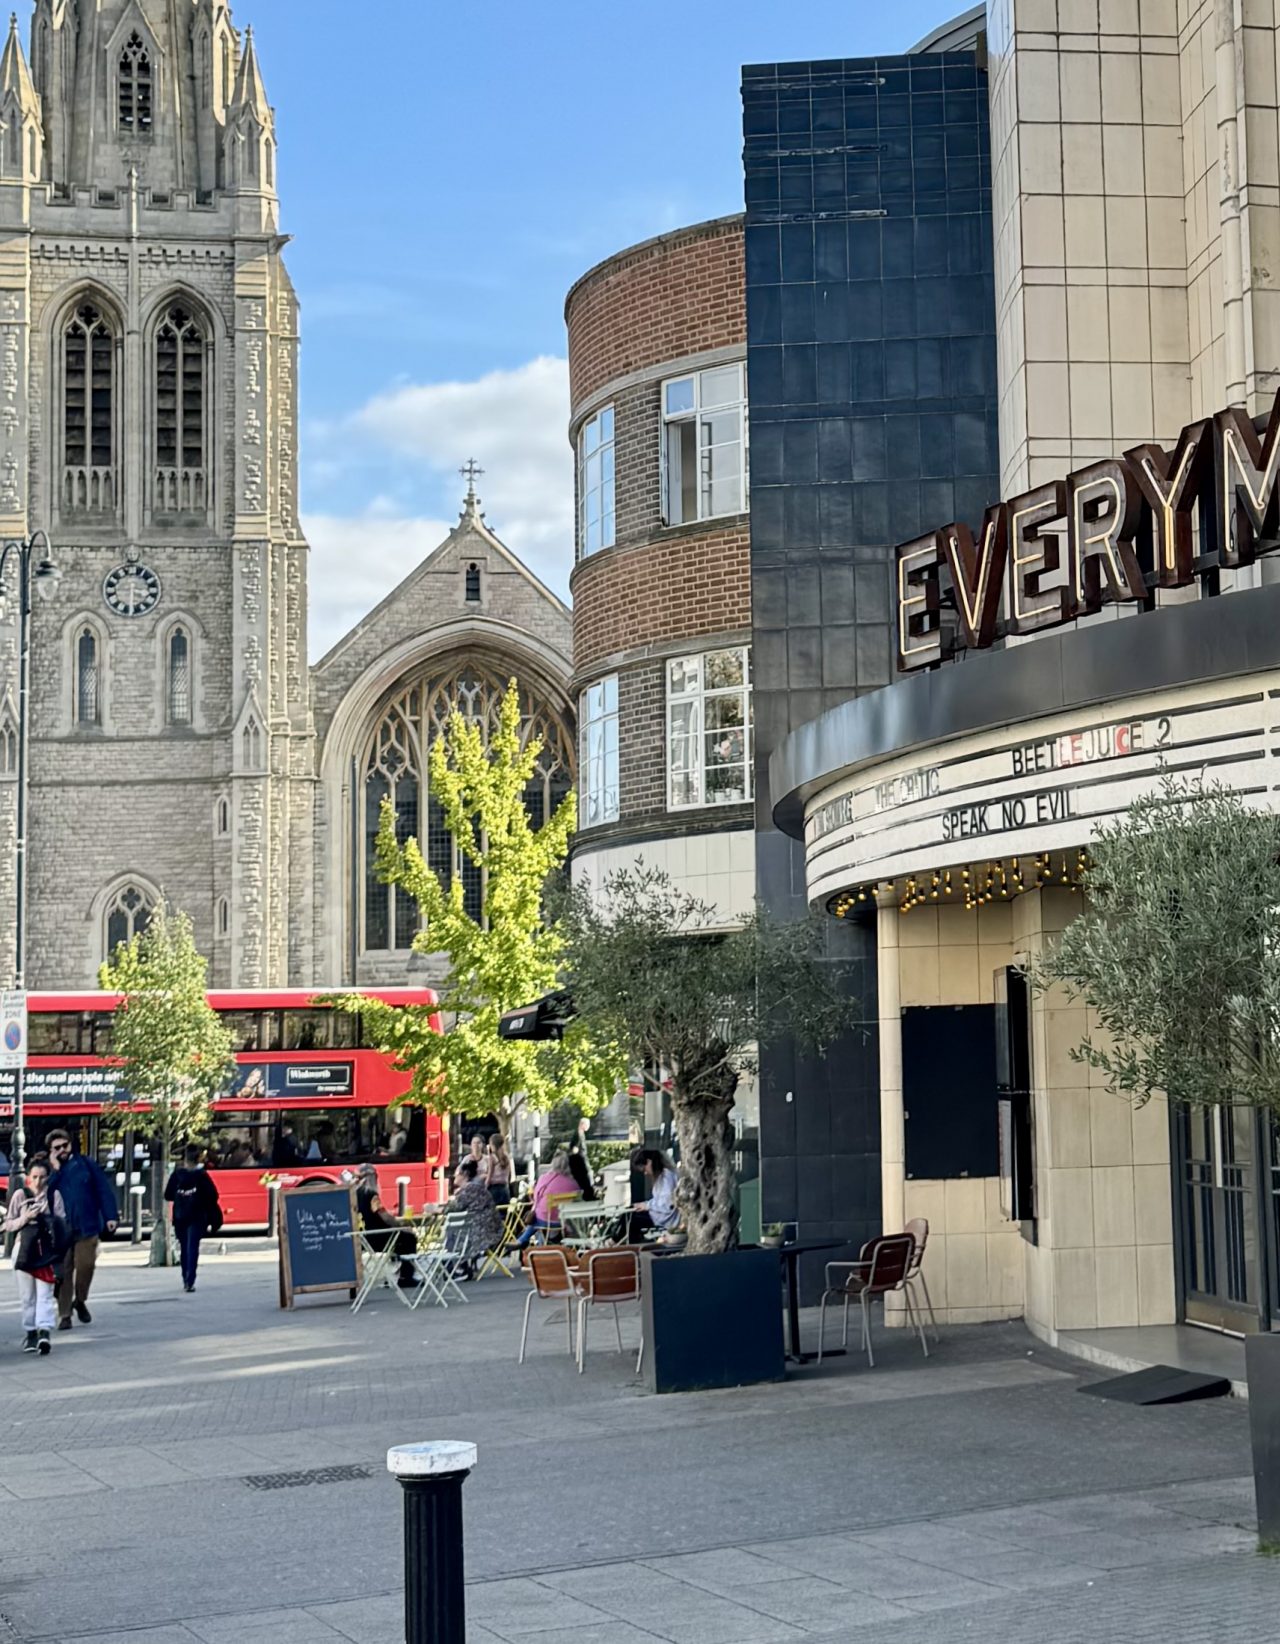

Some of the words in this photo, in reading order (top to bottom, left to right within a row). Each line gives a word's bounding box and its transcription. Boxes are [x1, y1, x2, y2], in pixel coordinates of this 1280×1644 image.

[1012, 722, 1144, 775] BEETLEJUICE
[1156, 717, 1172, 747] 2
[942, 804, 989, 840] SPEAK
[1002, 799, 1026, 829] NO
[1036, 789, 1077, 824] EVIL
